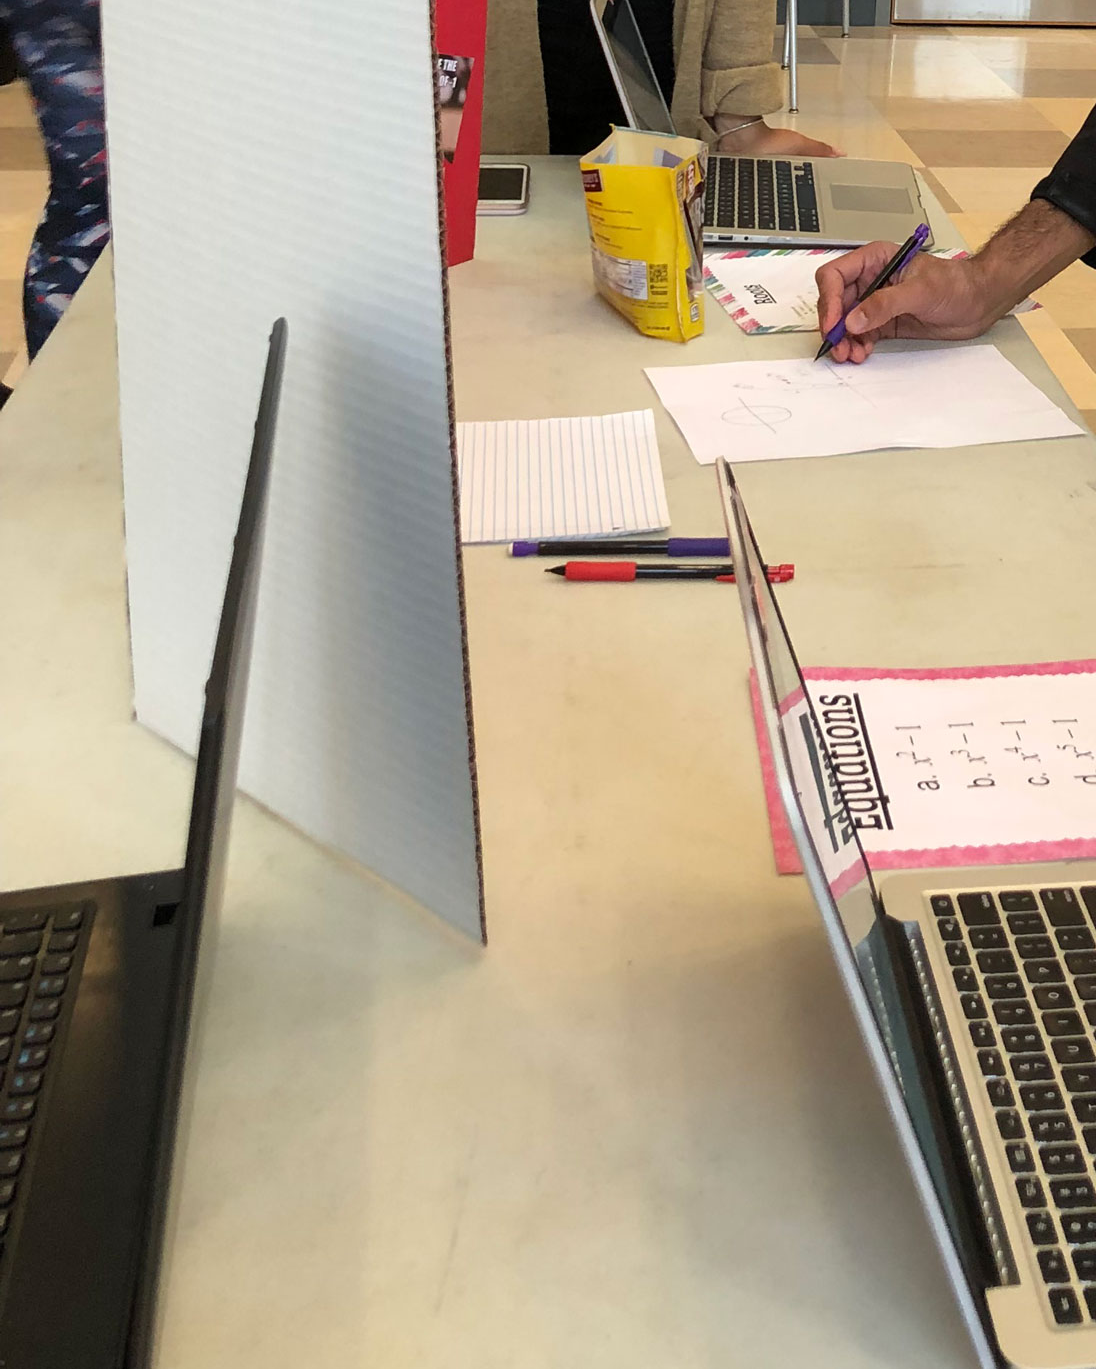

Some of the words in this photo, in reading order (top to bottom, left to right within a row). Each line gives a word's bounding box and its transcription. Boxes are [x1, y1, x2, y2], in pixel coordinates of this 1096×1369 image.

[819, 694, 890, 830] Equations
[917, 775, 941, 791] a.
[966, 773, 996, 789] b.
[1027, 772, 1050, 786] c.
[1067, 1045, 1080, 1053] U
